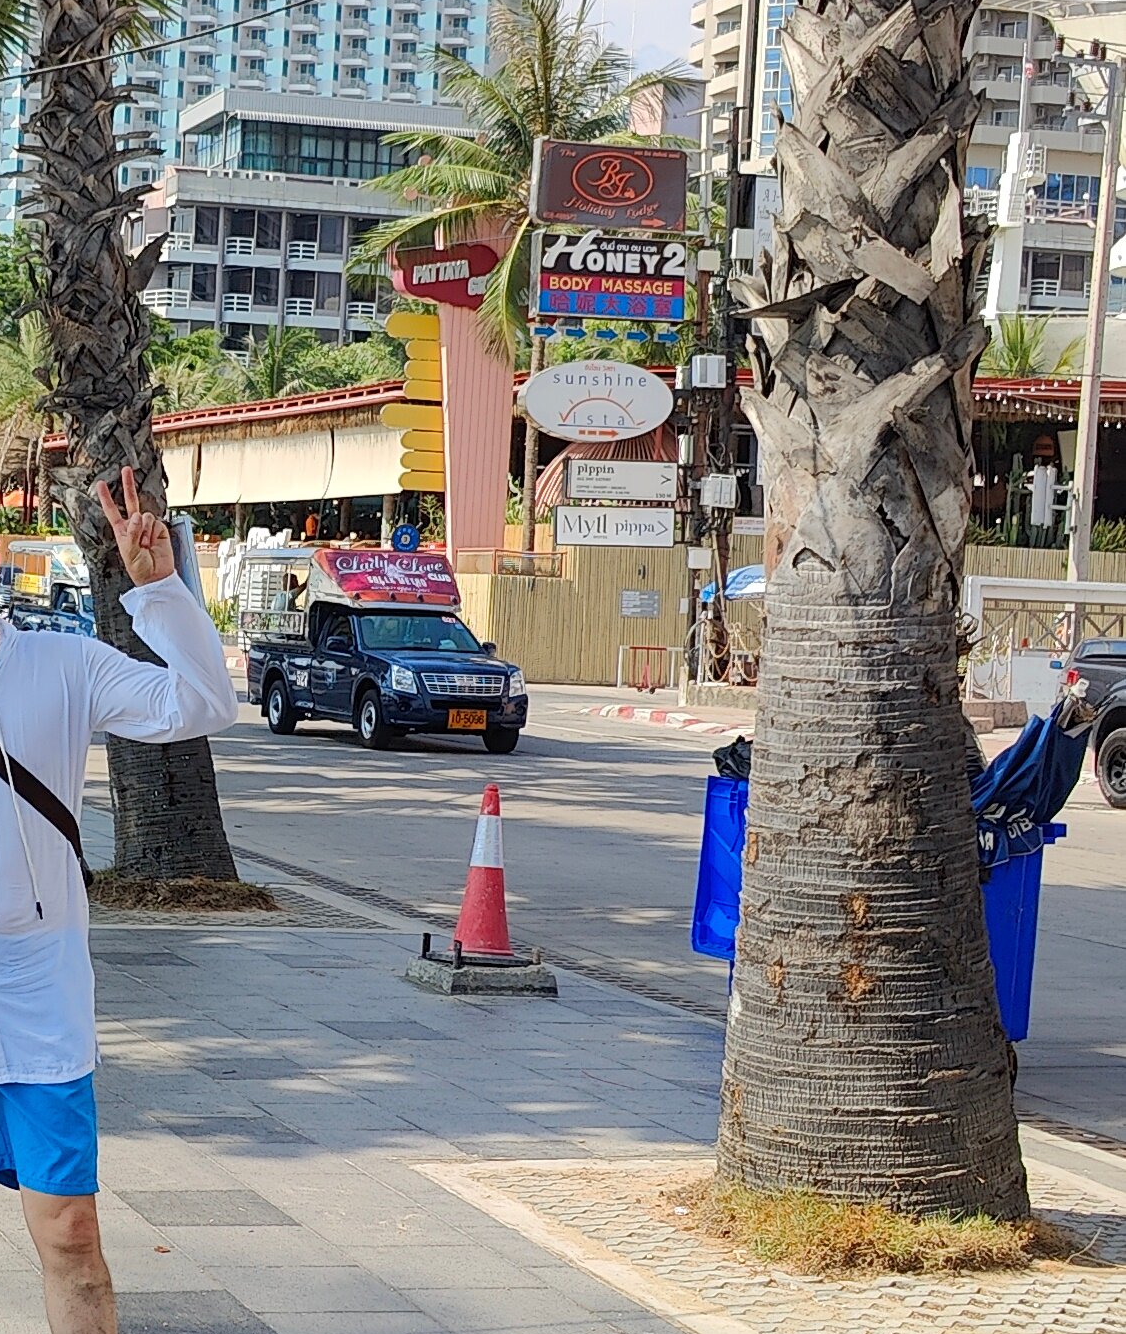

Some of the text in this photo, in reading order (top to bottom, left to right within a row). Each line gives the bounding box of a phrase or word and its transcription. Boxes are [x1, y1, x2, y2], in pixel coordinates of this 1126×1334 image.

[559, 148, 577, 157] The
[563, 196, 617, 219] Holiday
[542, 229, 685, 276] HONEY 2
[412, 259, 470, 285] PATTAYA
[549, 276, 674, 296] BODY MASSAGE
[553, 372, 647, 388] sunshine
[577, 463, 615, 476] pippin
[615, 520, 655, 537] pippa
[336, 556, 389, 575] Lady
[427, 573, 452, 583] CLUB
